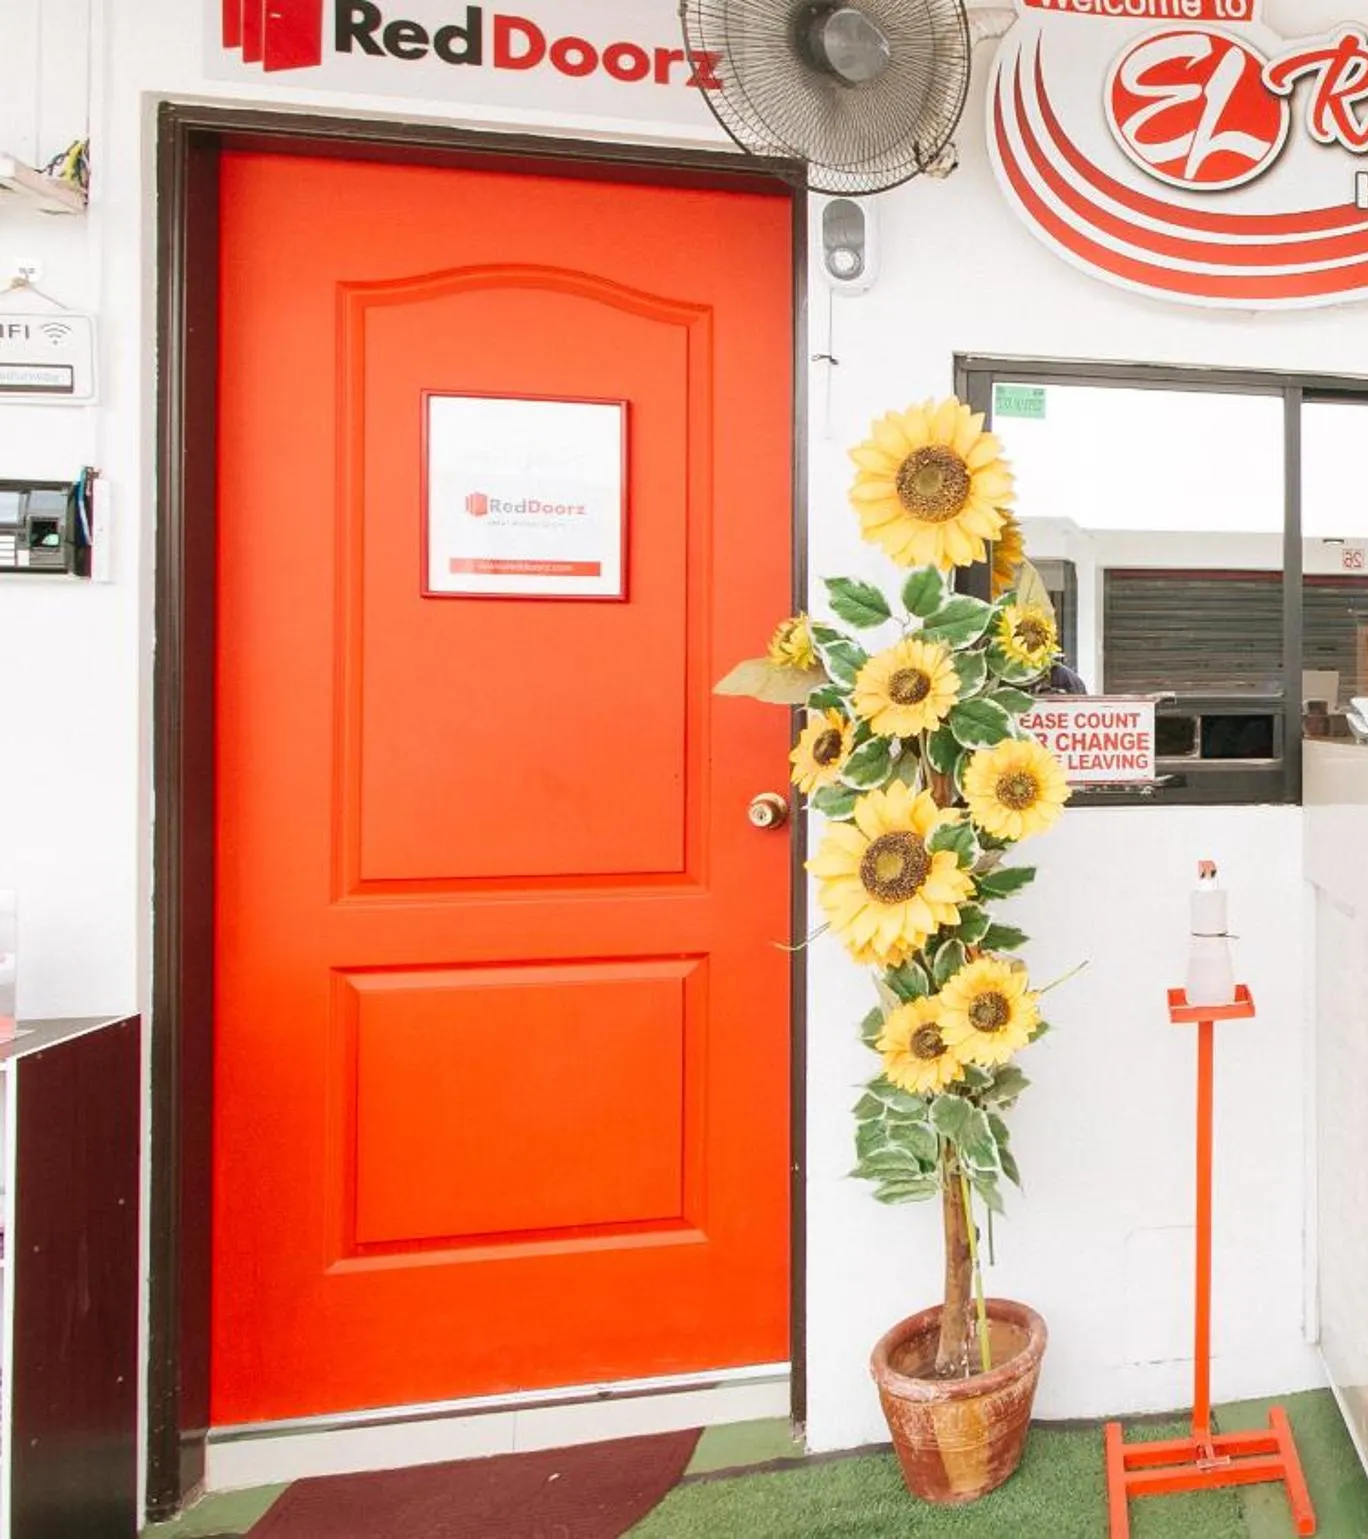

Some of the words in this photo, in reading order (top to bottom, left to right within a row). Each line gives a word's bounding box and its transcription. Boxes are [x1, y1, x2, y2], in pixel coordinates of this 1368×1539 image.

[335, 0, 724, 91] RedDoorz
[0, 323, 30, 340] IFI
[490, 498, 587, 516] RedDoorz
[1018, 713, 1070, 729] EASE
[1073, 713, 1141, 729] COUNT
[1055, 732, 1150, 751] CHANGE
[1067, 754, 1149, 770] LEAVING
